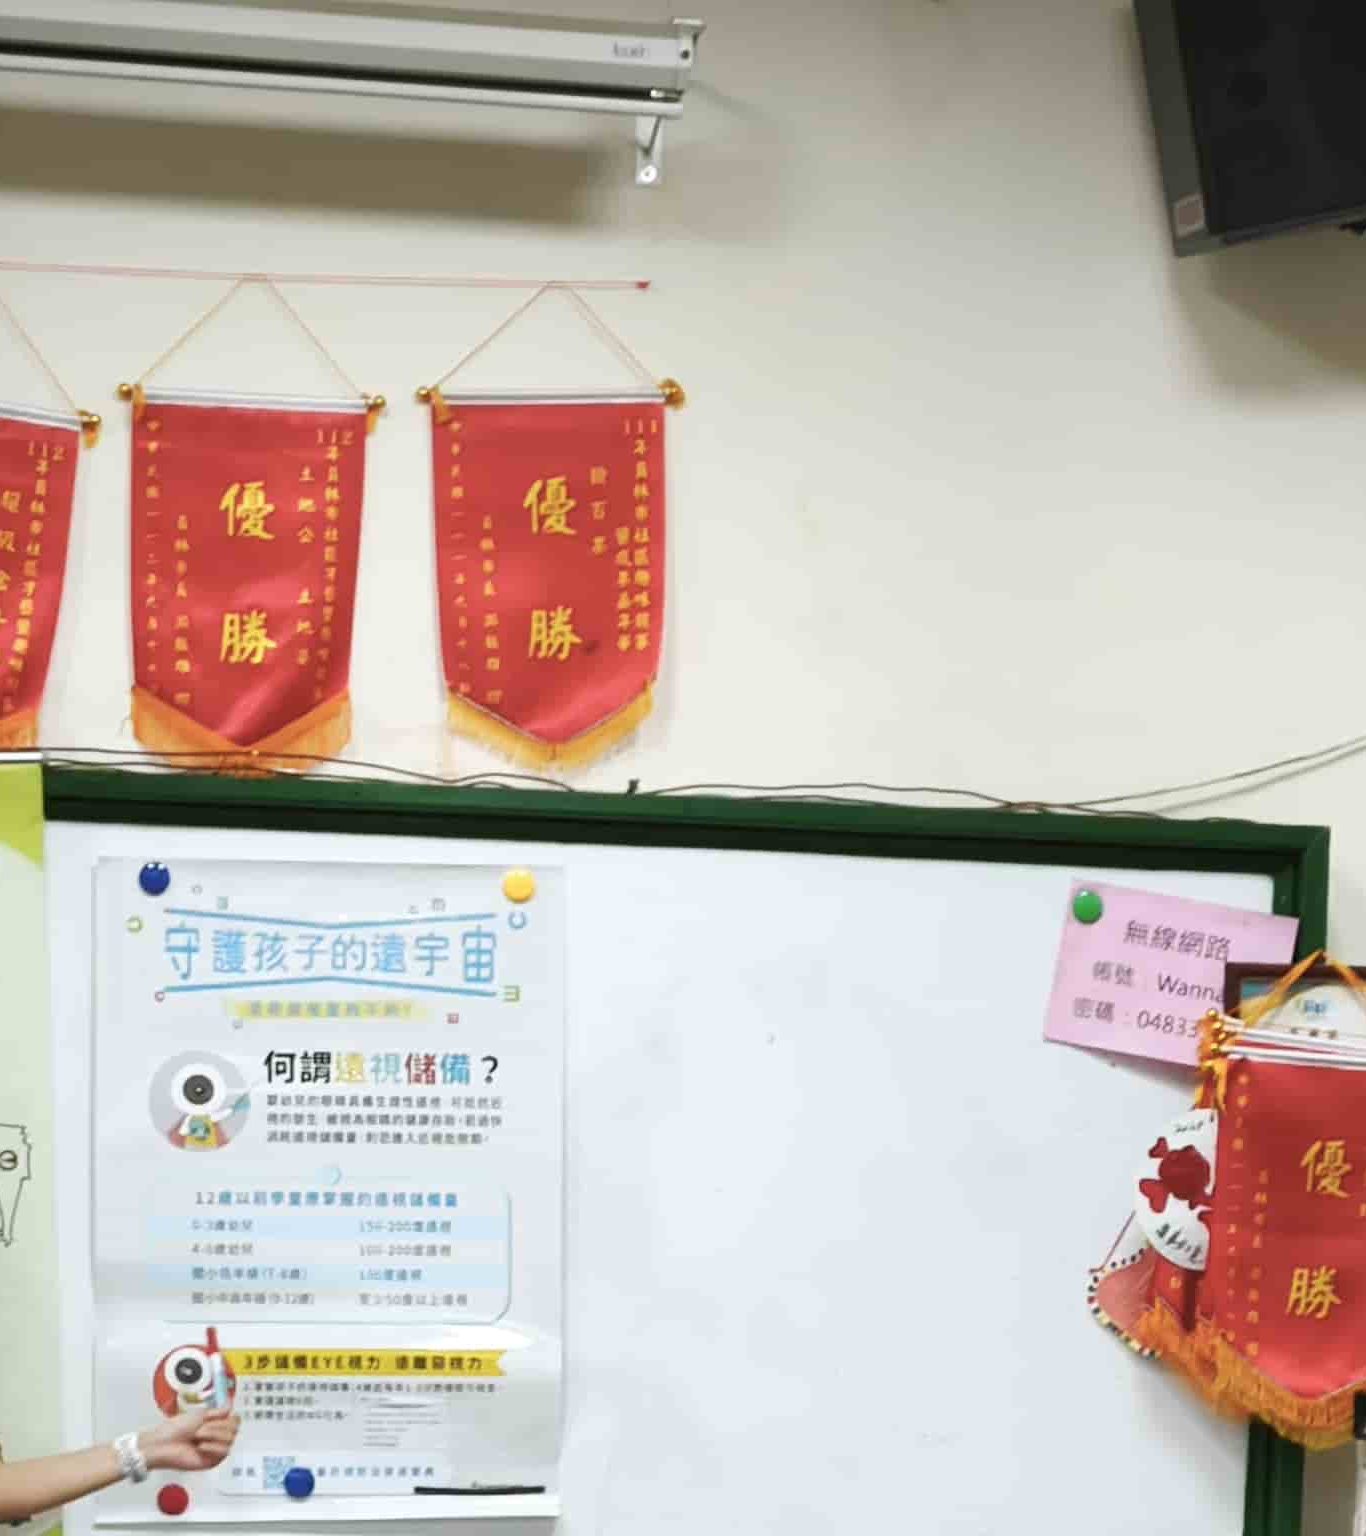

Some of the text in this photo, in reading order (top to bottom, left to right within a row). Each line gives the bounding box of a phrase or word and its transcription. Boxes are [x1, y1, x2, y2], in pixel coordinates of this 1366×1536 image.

[219, 480, 277, 663] 優勝
[522, 475, 581, 660] 優勝
[1123, 920, 1231, 961] 無線網路
[1286, 1140, 1352, 1319] 優勝
